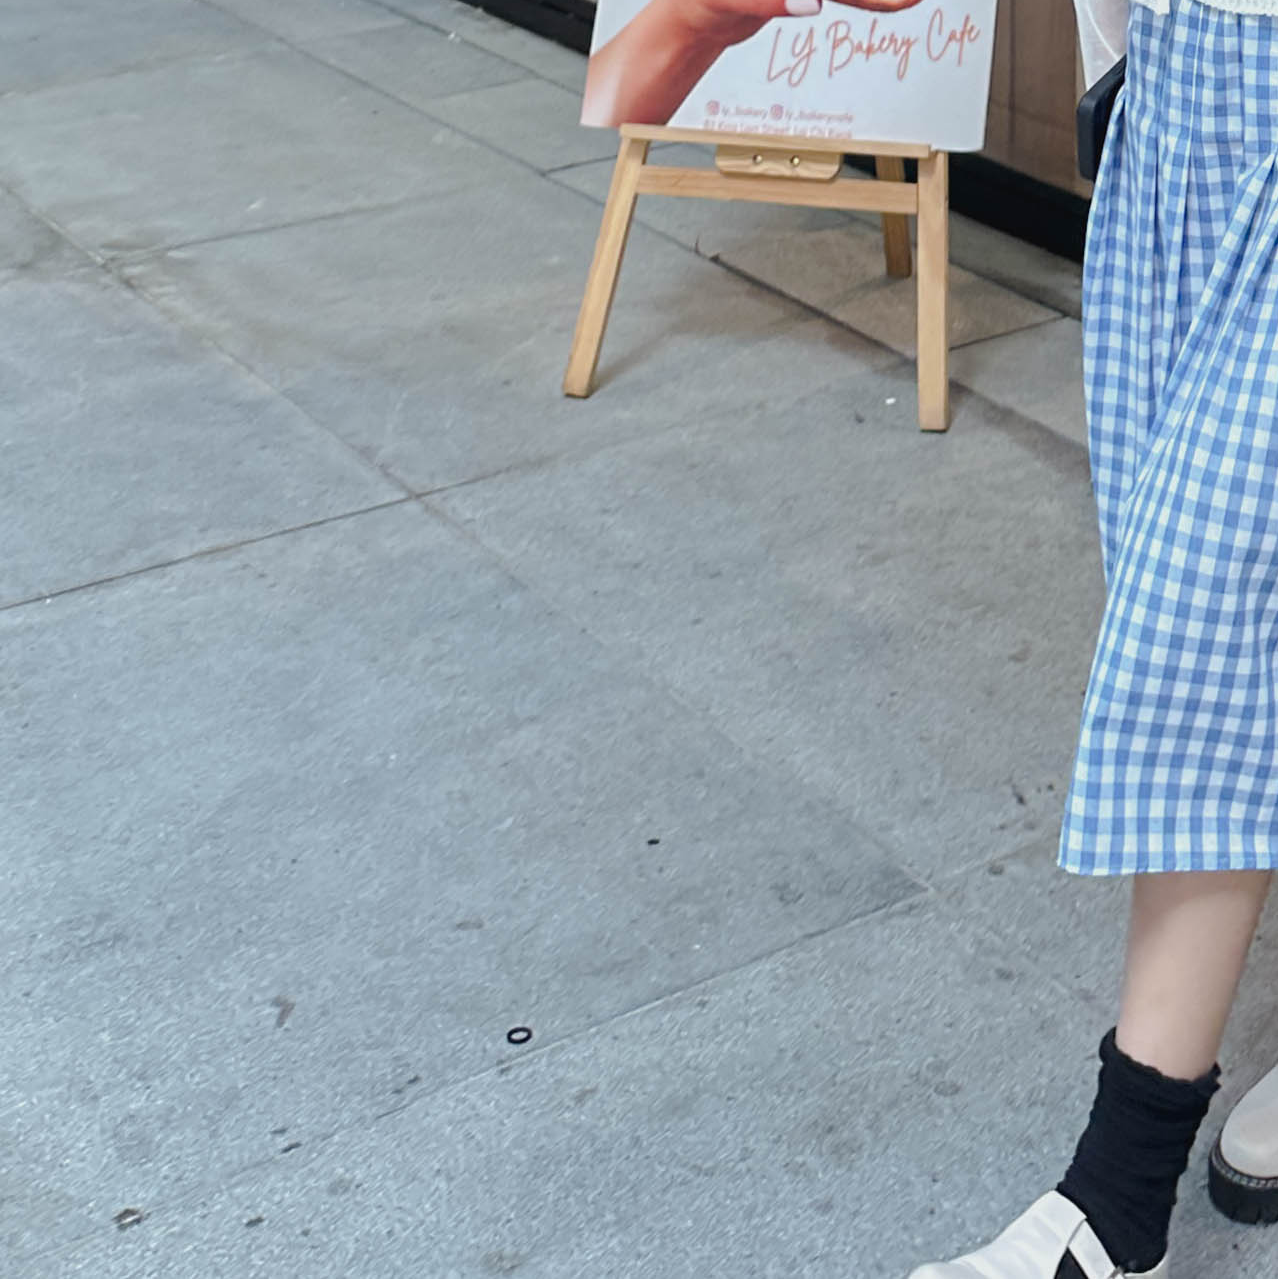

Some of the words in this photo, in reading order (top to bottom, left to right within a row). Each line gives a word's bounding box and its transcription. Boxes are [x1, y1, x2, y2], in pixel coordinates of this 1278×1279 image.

[767, 26, 817, 87] LY
[825, 17, 920, 82] Bakery
[927, 7, 981, 67] Cafe
